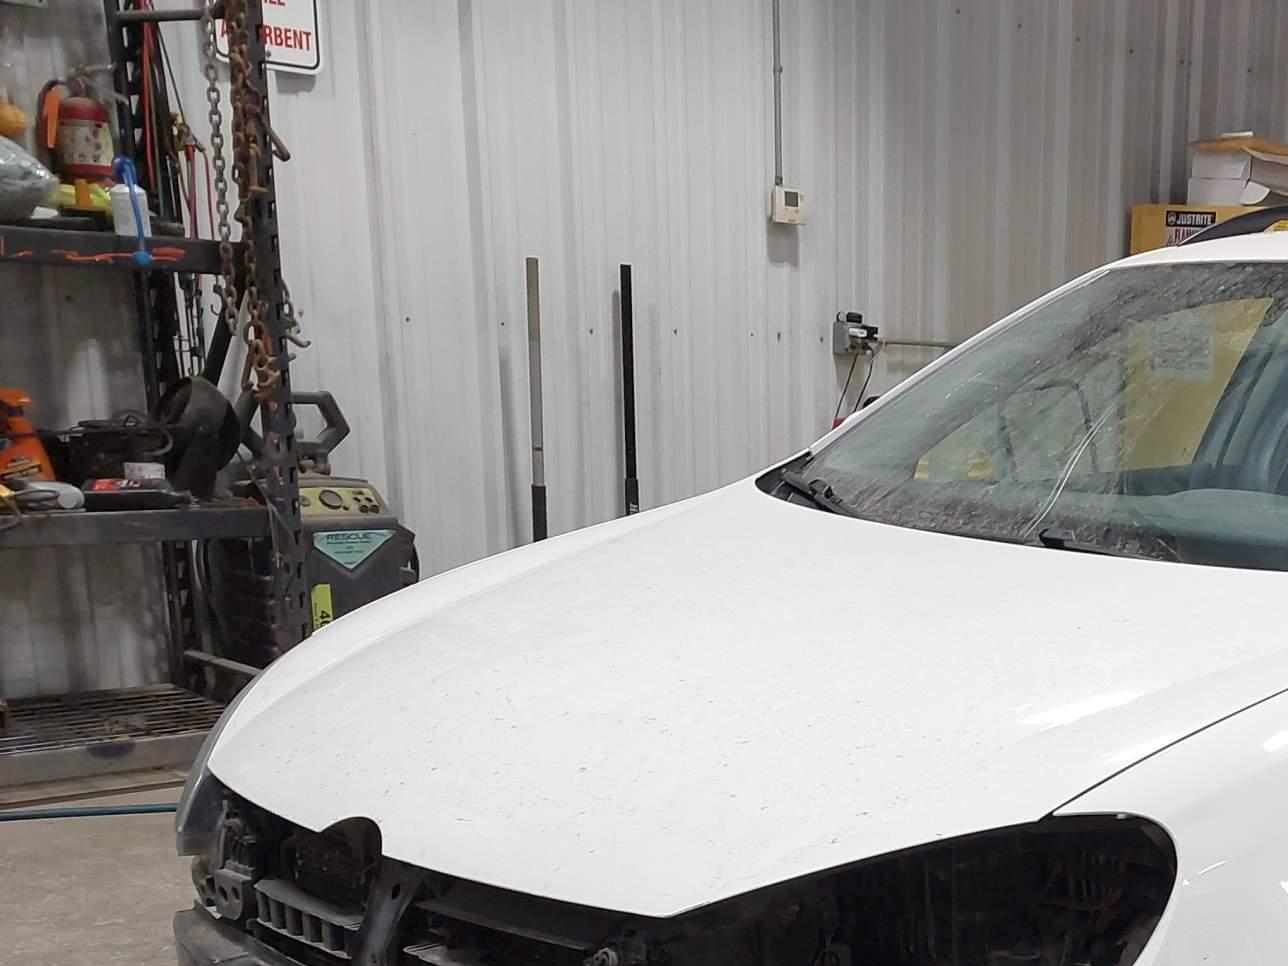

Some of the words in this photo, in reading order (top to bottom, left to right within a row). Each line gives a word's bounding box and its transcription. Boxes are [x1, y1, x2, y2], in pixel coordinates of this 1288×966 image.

[220, 19, 312, 51] ARBENT
[1176, 213, 1212, 225] JUSTRITE
[326, 533, 370, 541] RESCUE
